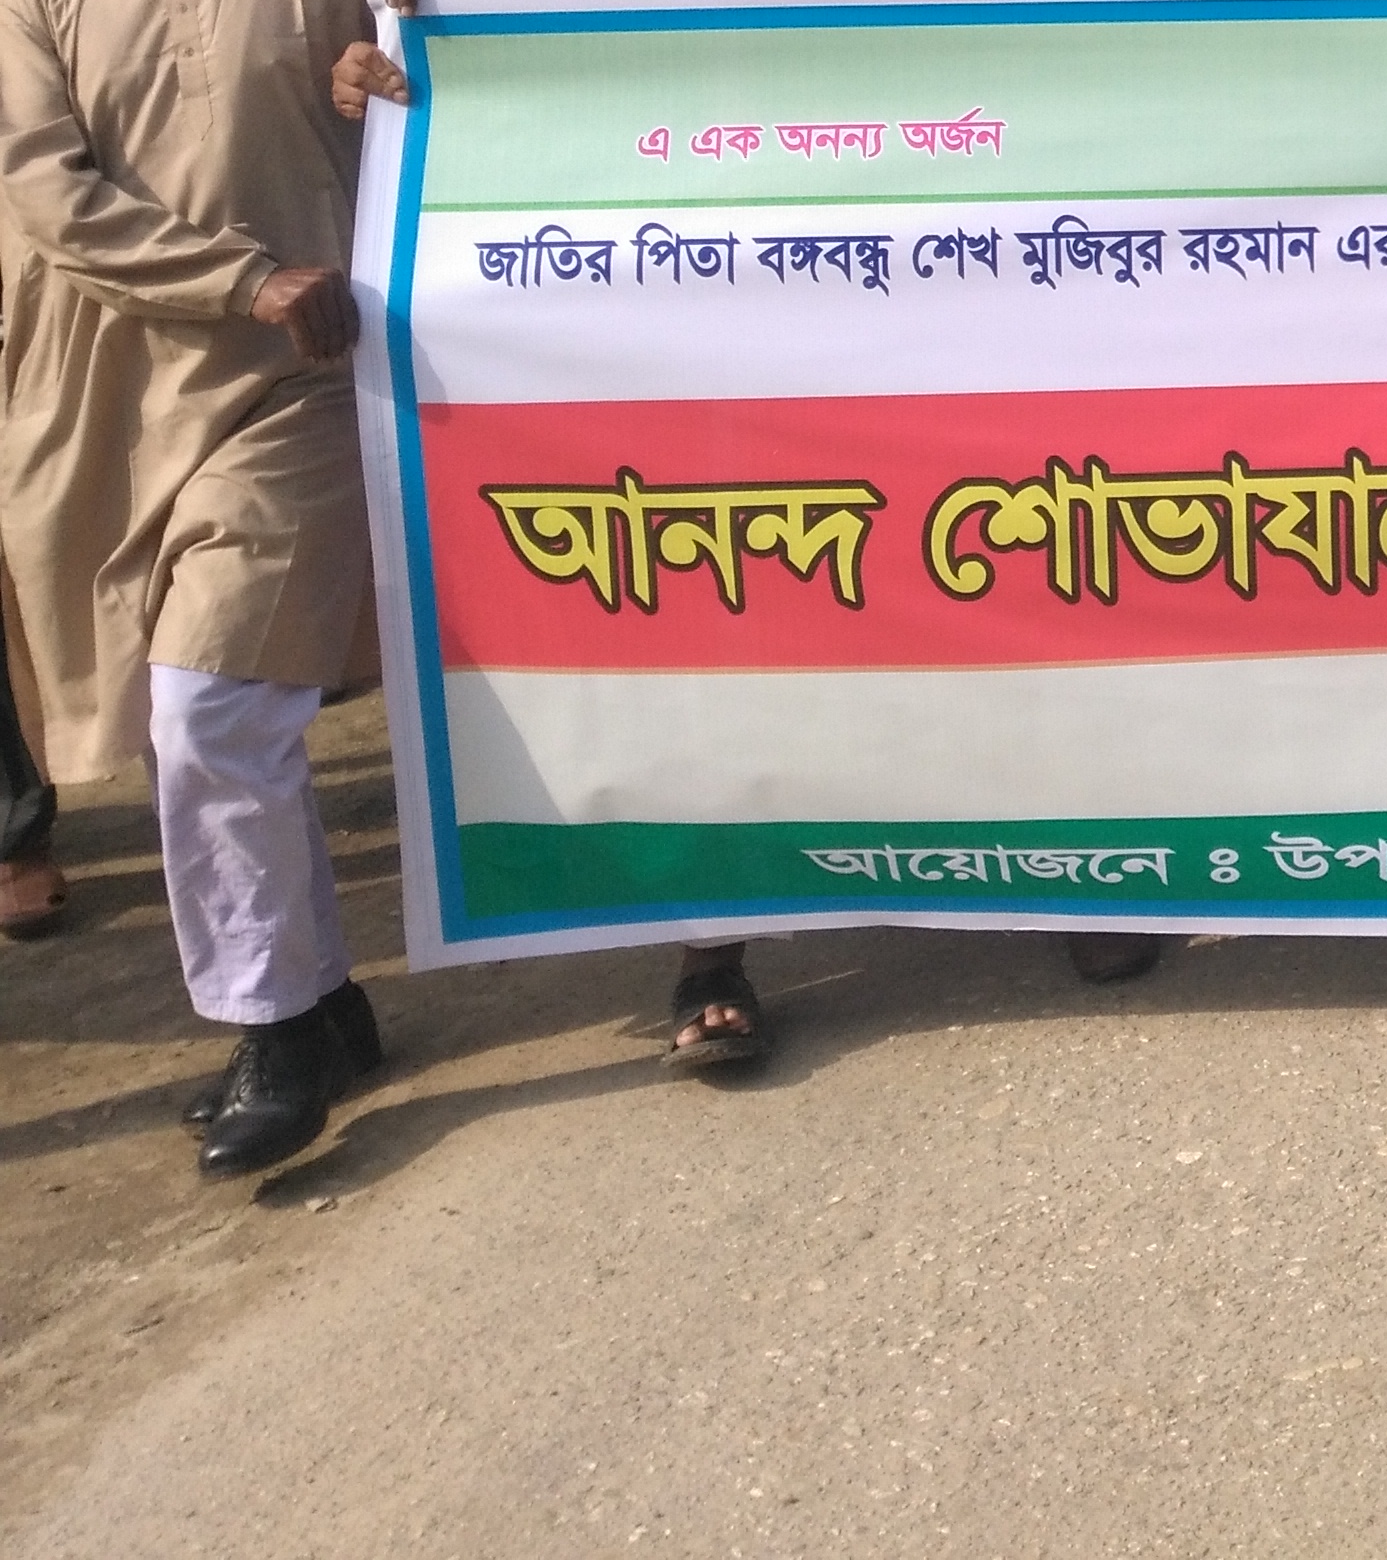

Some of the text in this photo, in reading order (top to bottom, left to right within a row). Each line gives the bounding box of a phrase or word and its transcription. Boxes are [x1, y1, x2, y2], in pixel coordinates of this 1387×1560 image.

[638, 107, 1006, 162] এ এক অনন্য অর্জন
[474, 224, 618, 289] জাতির
[630, 222, 741, 286] পিতা
[752, 235, 895, 297] বঙ্গবন্ধু
[912, 226, 1003, 280] শেখ
[1013, 214, 1168, 290] মুজিবুর
[1177, 220, 1320, 279] রহমান
[479, 466, 887, 614] আনন্দ
[801, 843, 1176, 886] আয়োজনে
